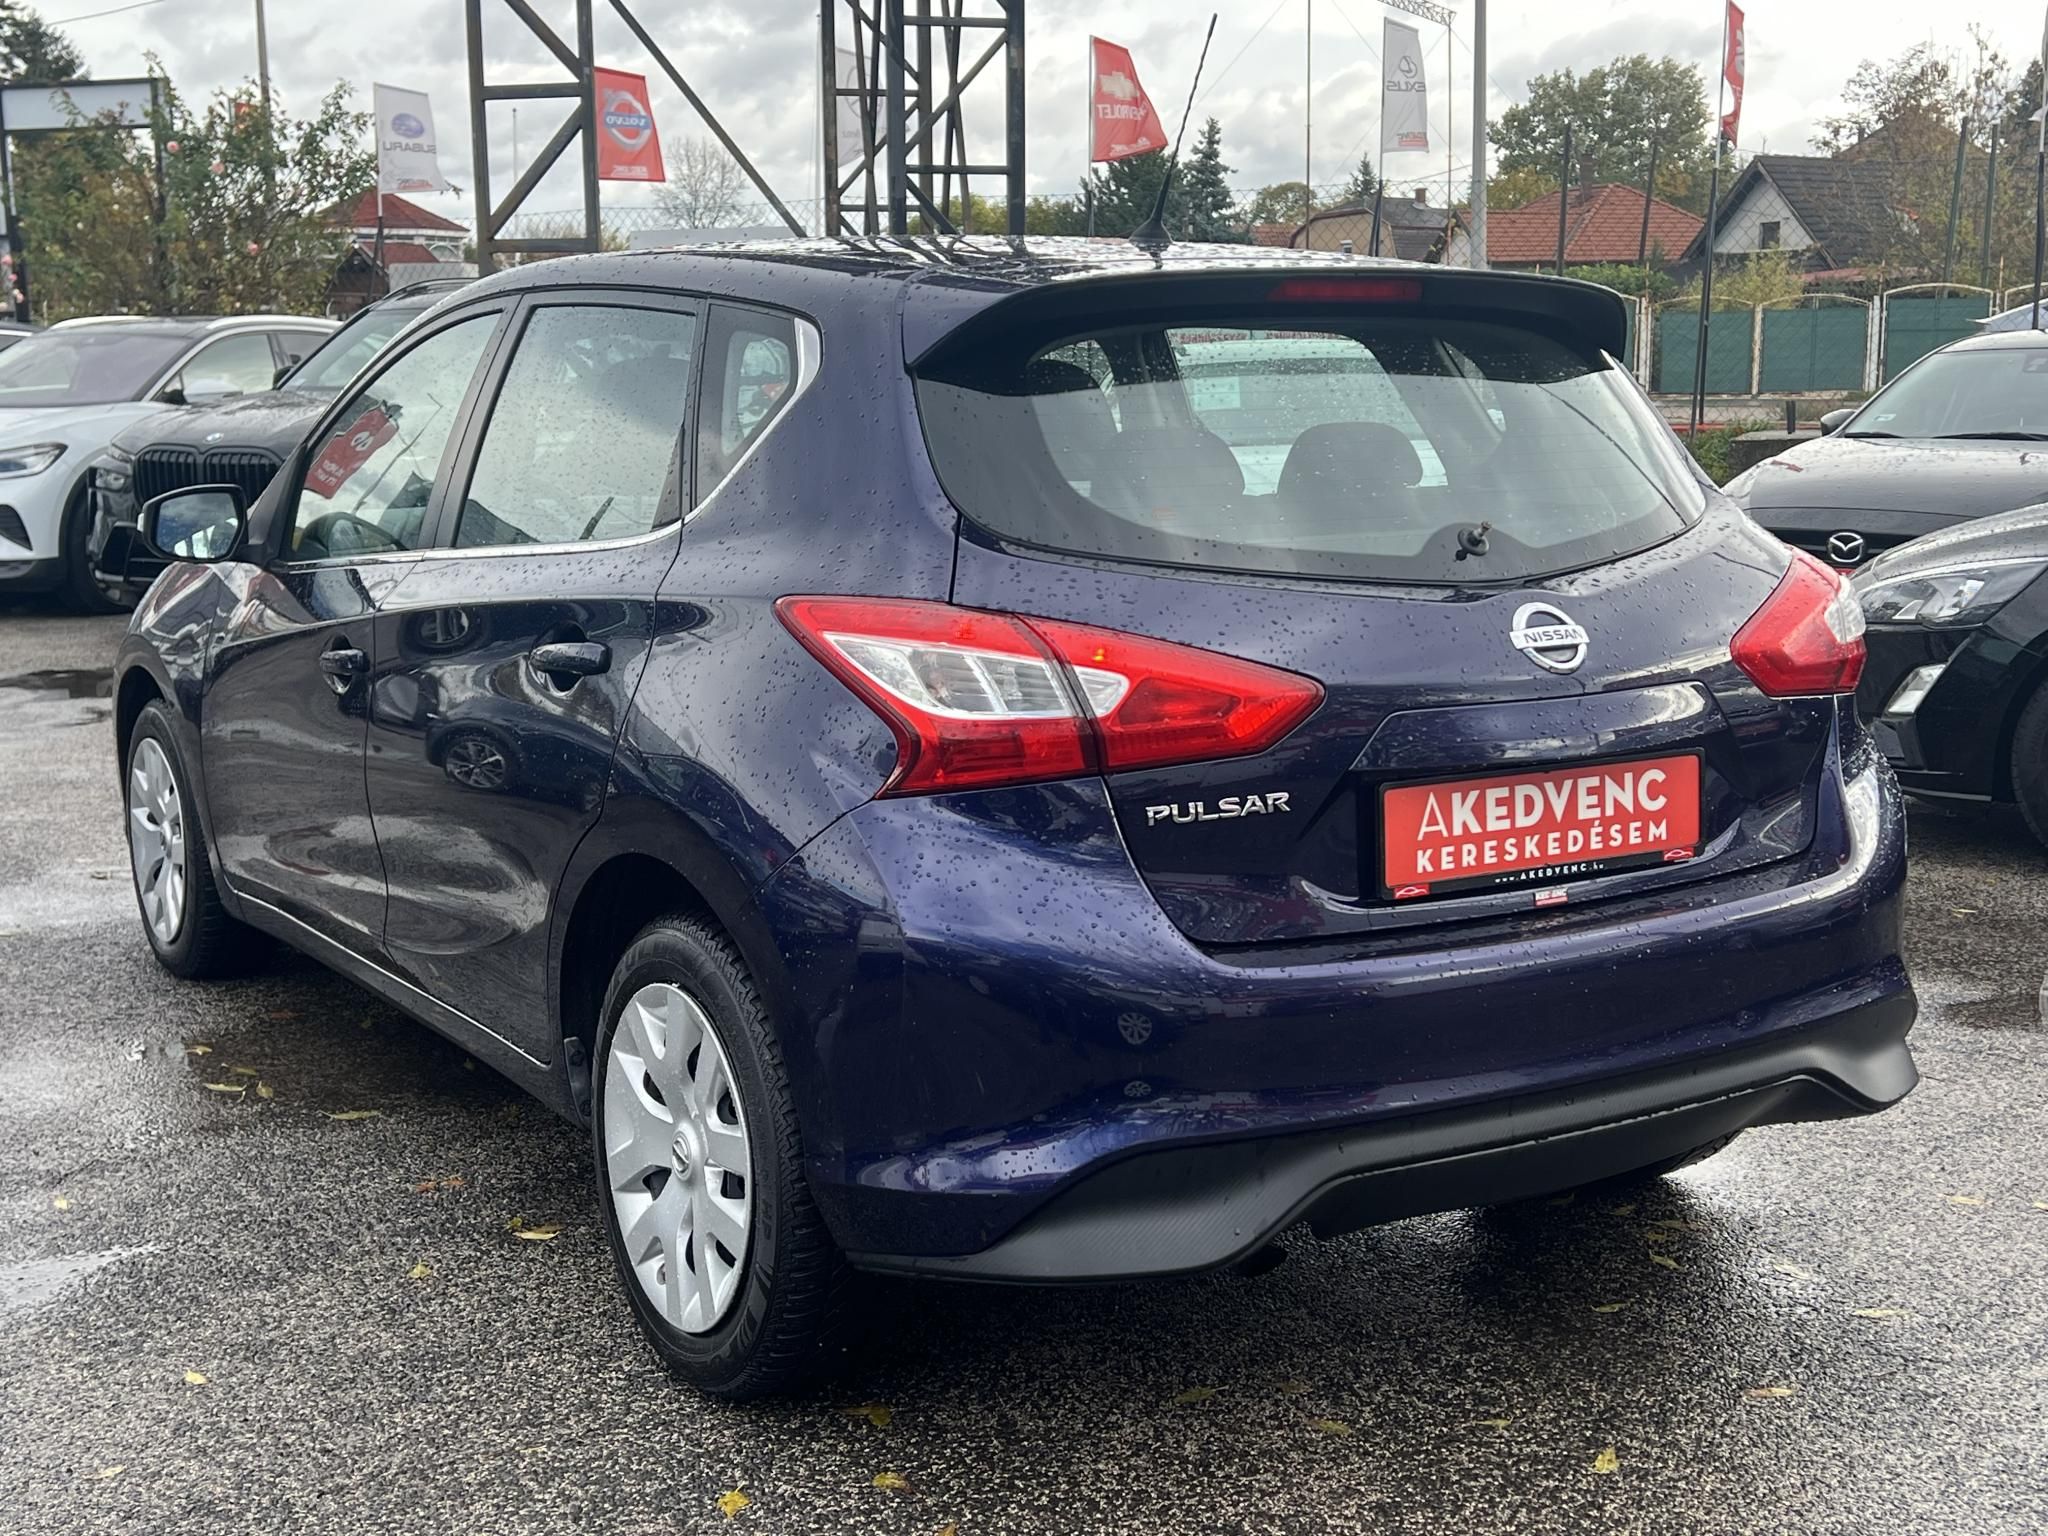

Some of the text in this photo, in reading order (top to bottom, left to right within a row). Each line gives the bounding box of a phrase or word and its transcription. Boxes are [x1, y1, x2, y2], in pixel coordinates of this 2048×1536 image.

[1523, 628, 1584, 644] NISSAN
[1145, 791, 1291, 827] PULSAR
[1416, 818, 1668, 874] KERESKEDÉSEM
